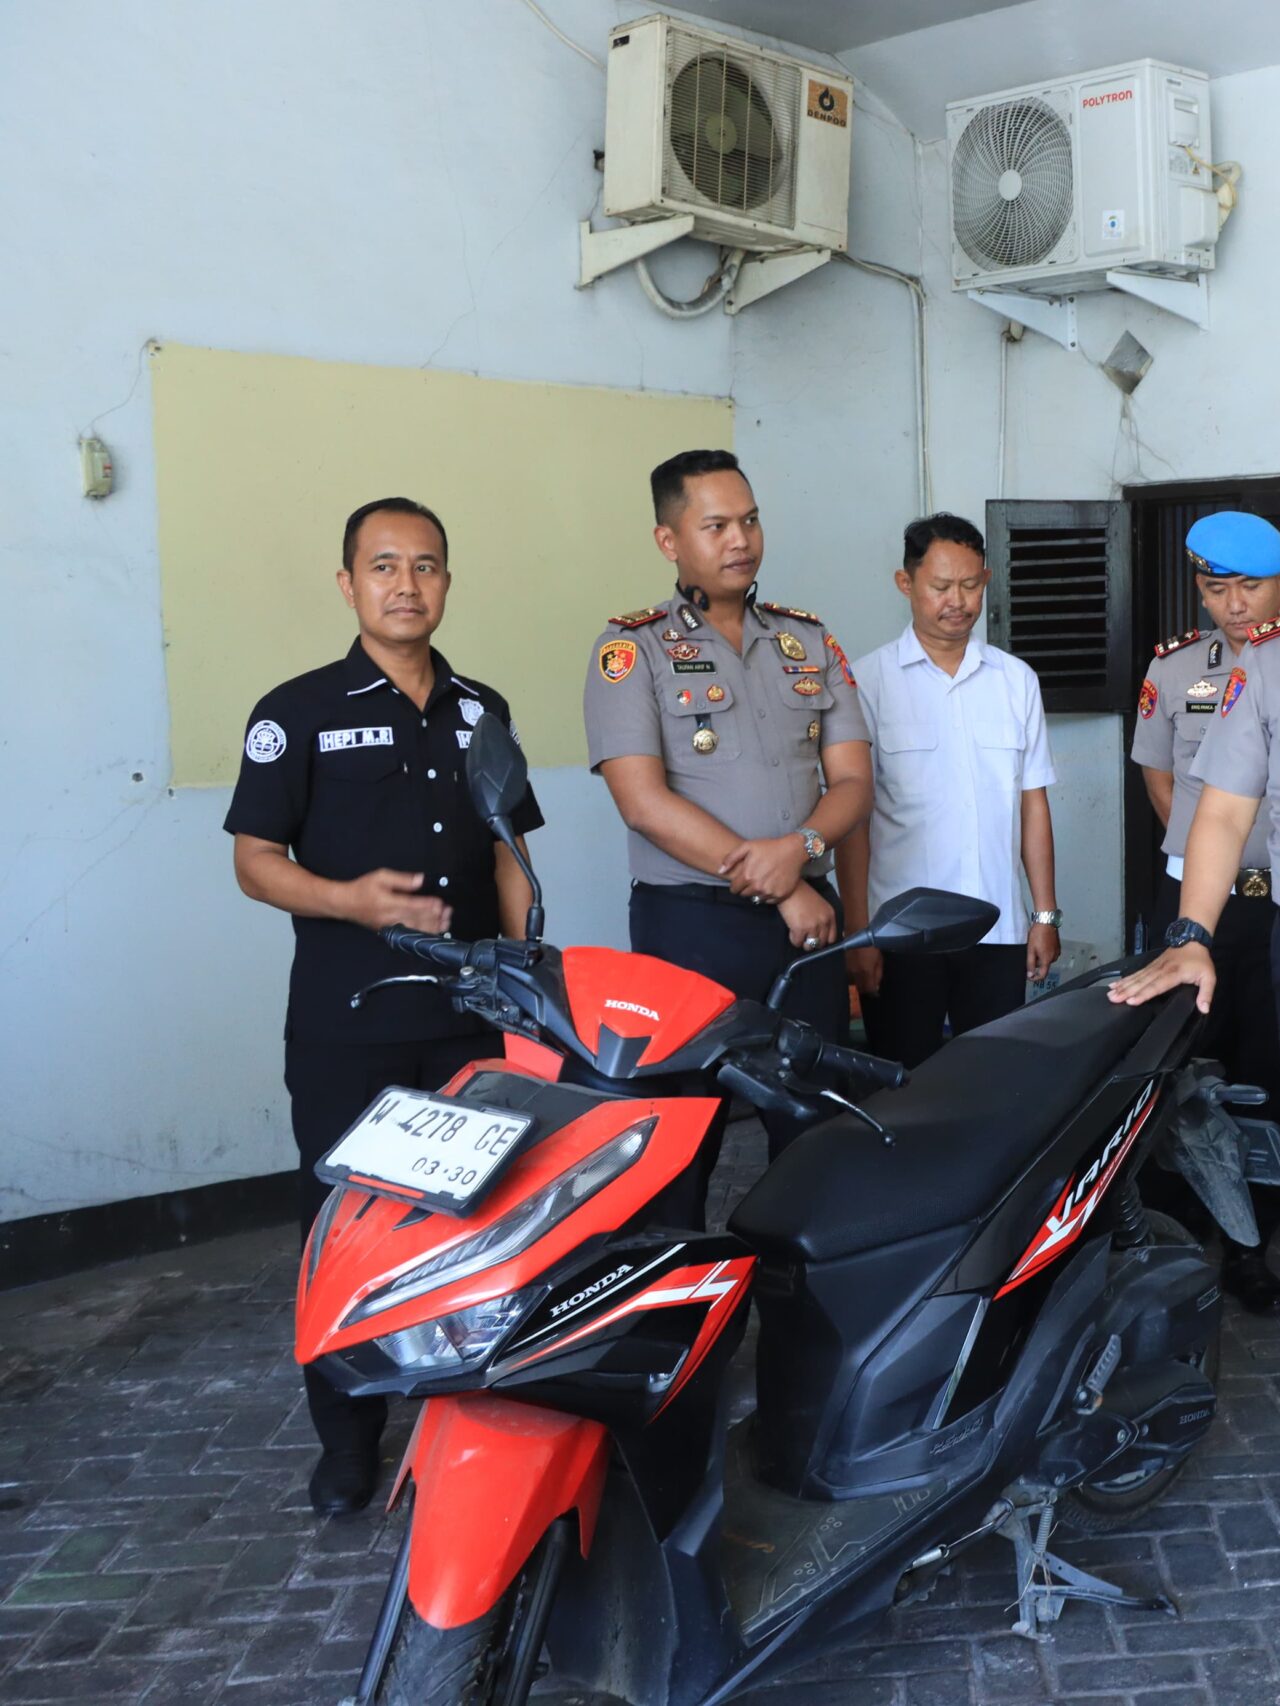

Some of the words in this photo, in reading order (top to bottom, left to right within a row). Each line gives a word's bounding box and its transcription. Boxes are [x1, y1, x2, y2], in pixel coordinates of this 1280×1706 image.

[1082, 89, 1133, 109] POLYTRON
[807, 109, 847, 128] DENPOO
[323, 731, 357, 750] HEPI
[604, 999, 660, 1021] HONDA
[369, 1098, 400, 1125] W
[397, 1107, 468, 1142] 4278
[1046, 1079, 1154, 1234] VARIO
[549, 1264, 634, 1318] HONDA
